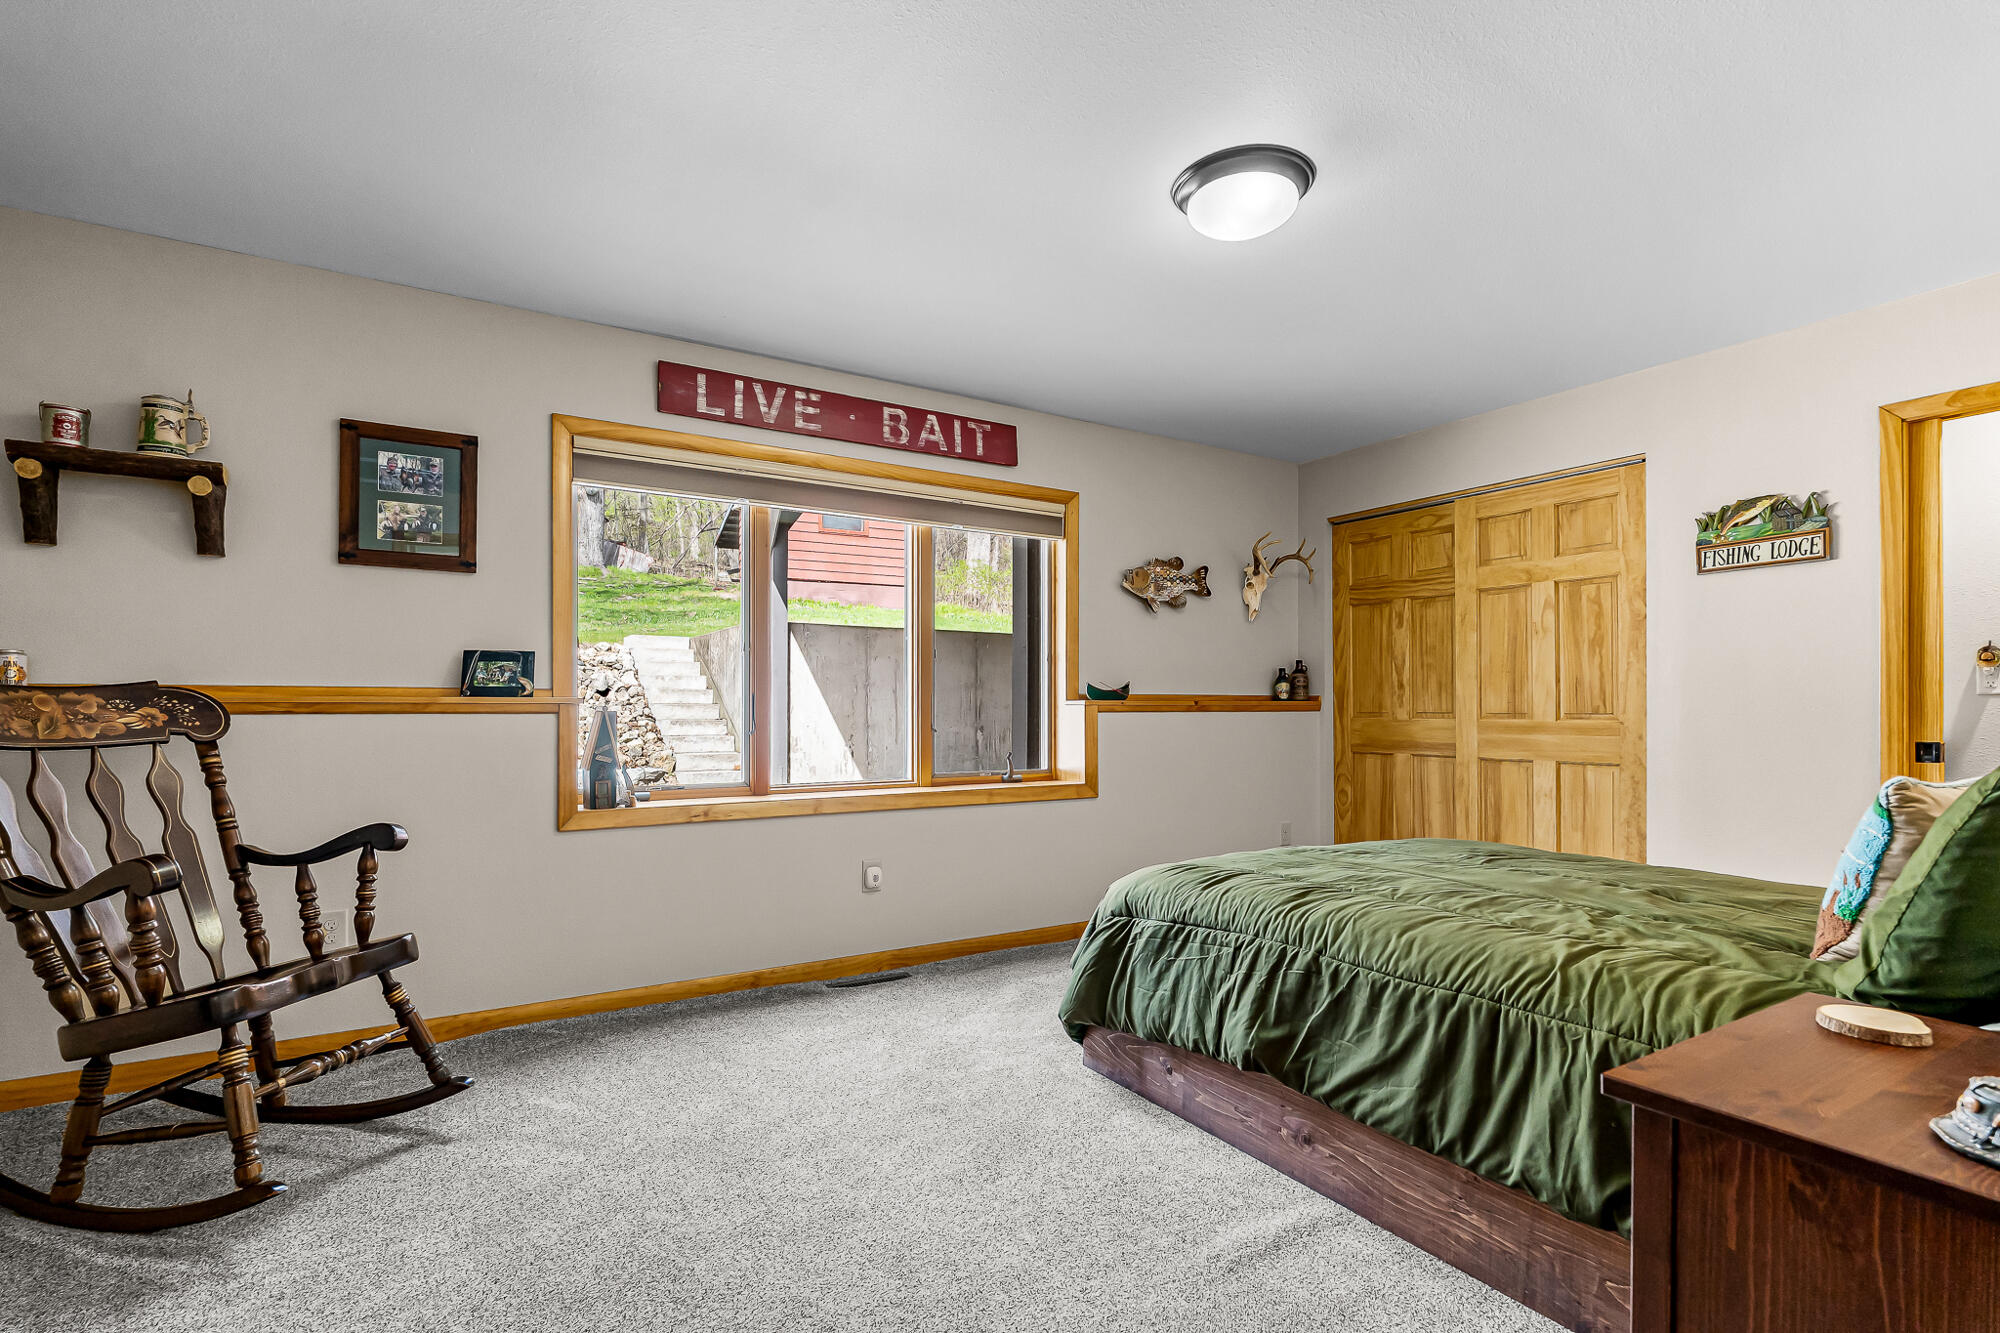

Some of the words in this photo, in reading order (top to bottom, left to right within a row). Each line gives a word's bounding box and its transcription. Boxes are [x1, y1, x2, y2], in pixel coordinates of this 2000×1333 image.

[696, 373, 822, 432] LIVE
[882, 406, 991, 456] BAIT
[1702, 544, 1761, 568] FISHING
[1770, 535, 1821, 559] LODGE
